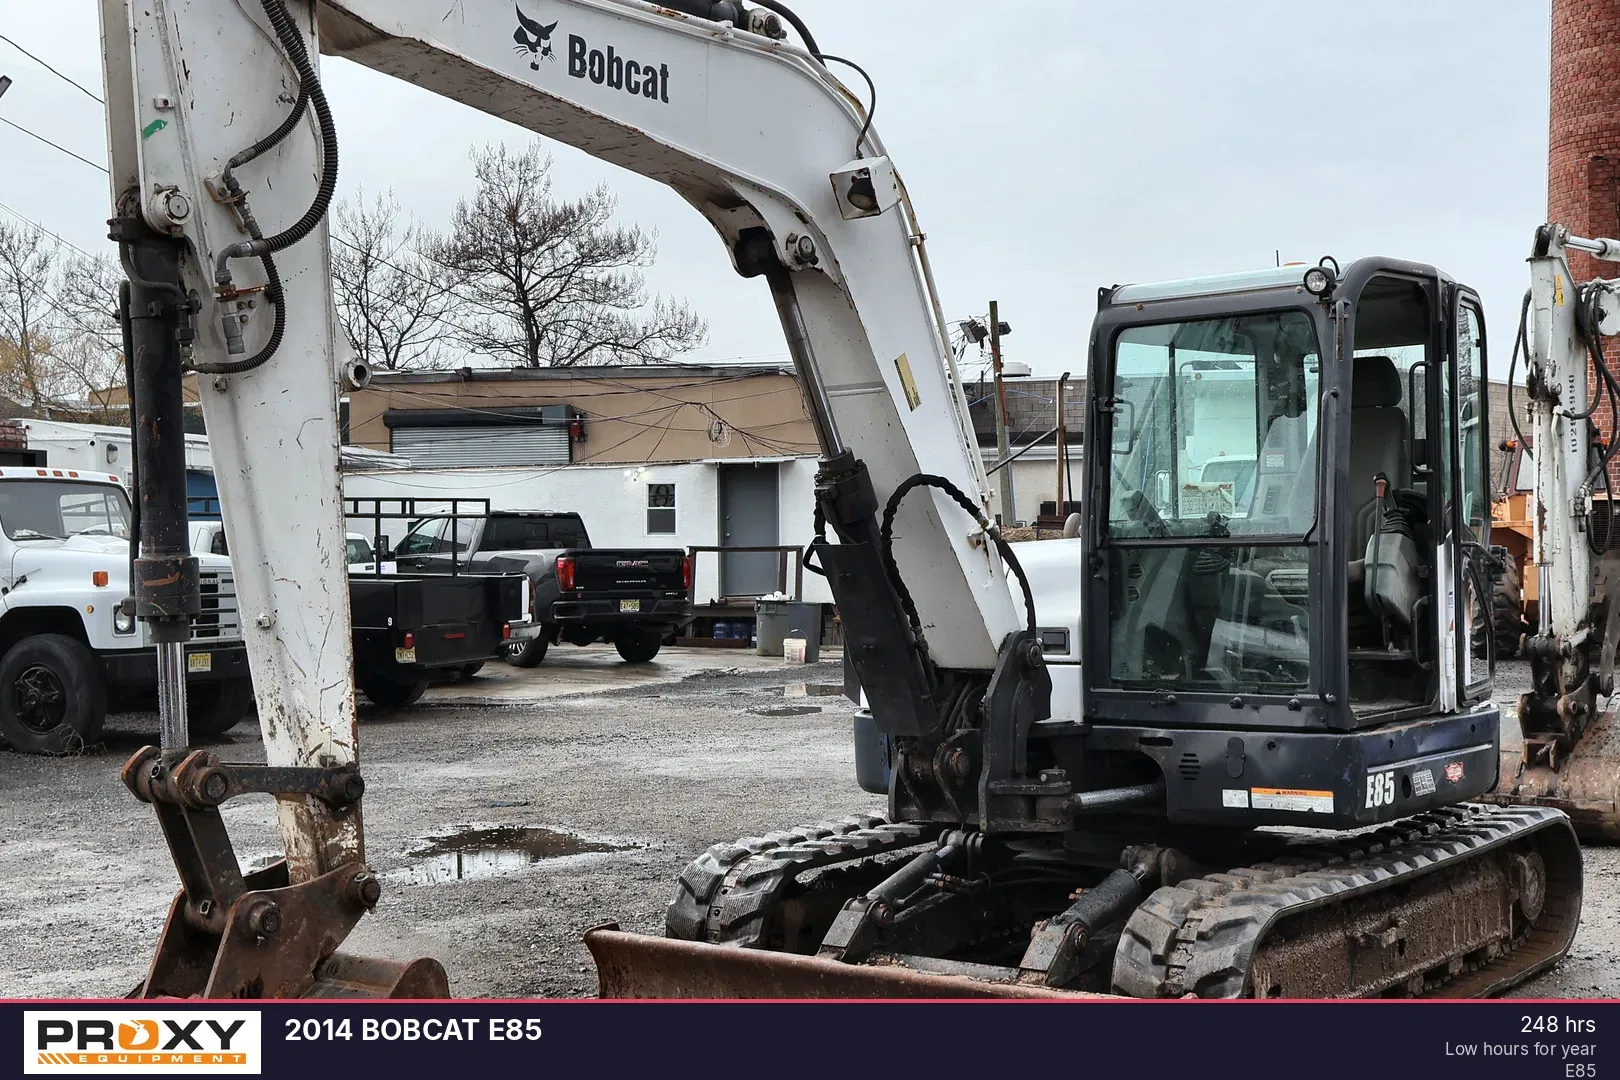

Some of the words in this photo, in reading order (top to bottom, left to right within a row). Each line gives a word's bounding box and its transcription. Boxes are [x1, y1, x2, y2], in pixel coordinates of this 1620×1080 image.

[568, 33, 669, 104] Bobcat
[387, 616, 393, 626] 9
[1365, 771, 1395, 809] E85
